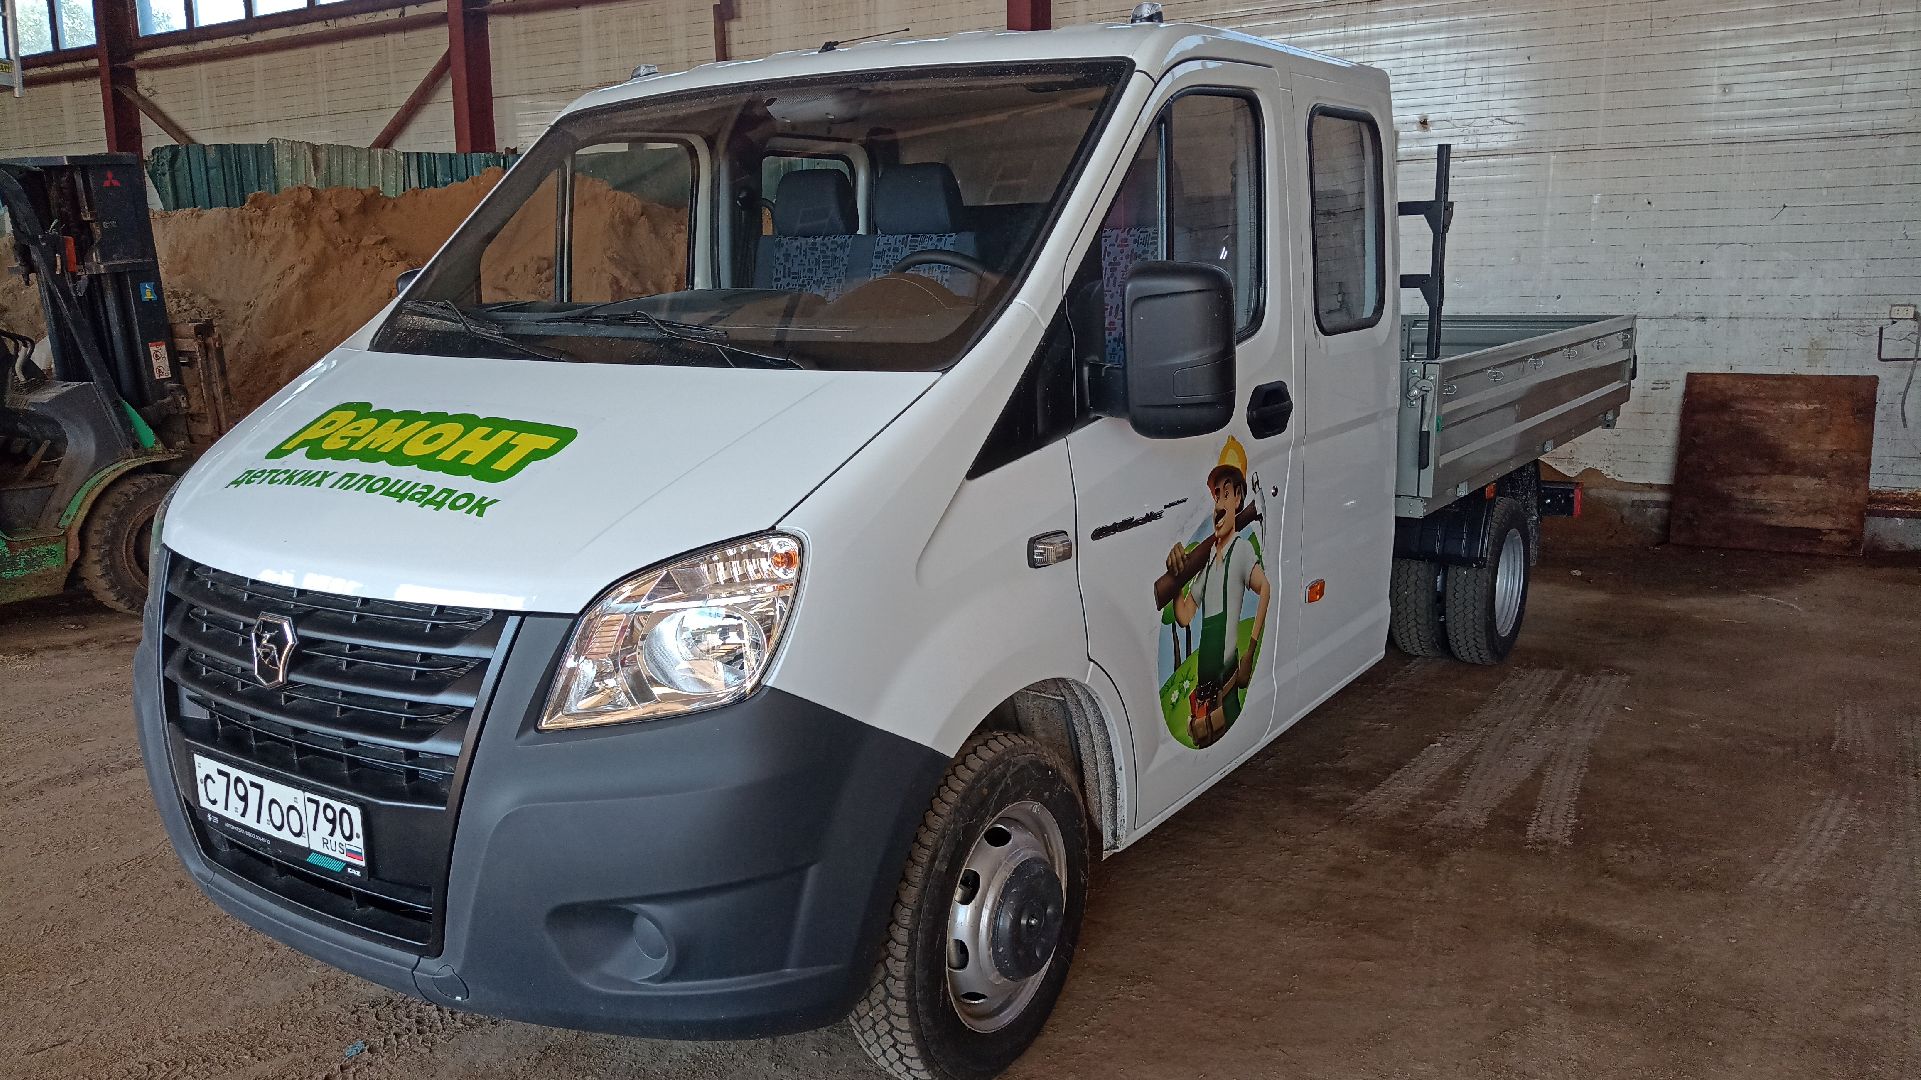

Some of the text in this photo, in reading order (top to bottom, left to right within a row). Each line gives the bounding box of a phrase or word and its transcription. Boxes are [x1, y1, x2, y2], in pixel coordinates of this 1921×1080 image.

[226, 468, 501, 519] детских площадок
[306, 799, 354, 842] 790
[321, 836, 346, 855] RUS
